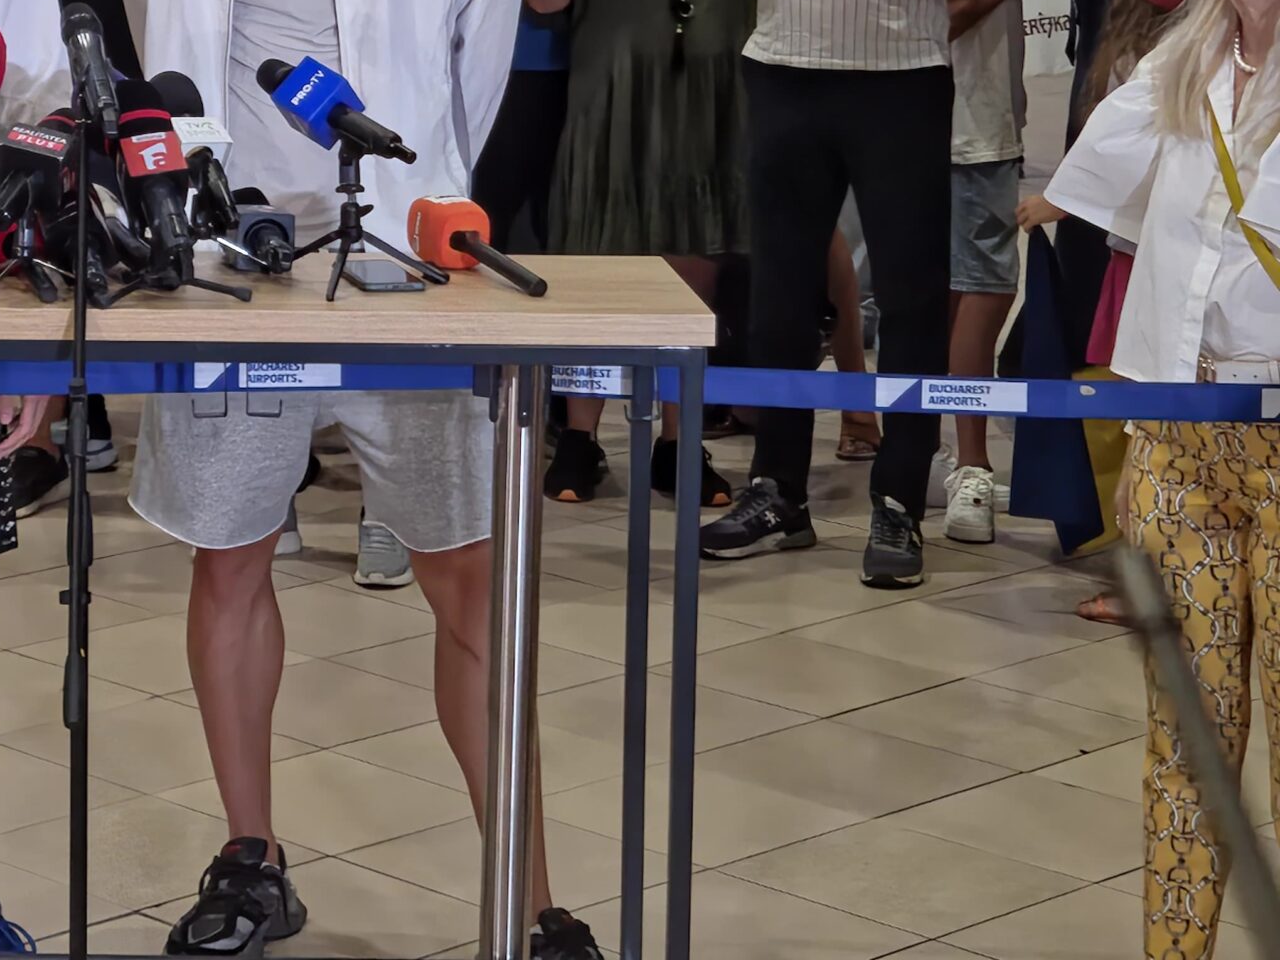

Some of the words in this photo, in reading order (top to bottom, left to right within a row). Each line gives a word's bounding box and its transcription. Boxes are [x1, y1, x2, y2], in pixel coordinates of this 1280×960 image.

[12, 126, 67, 144] REALITATEA
[16, 134, 55, 149] PLUS
[928, 384, 991, 394] BUCHAREST
